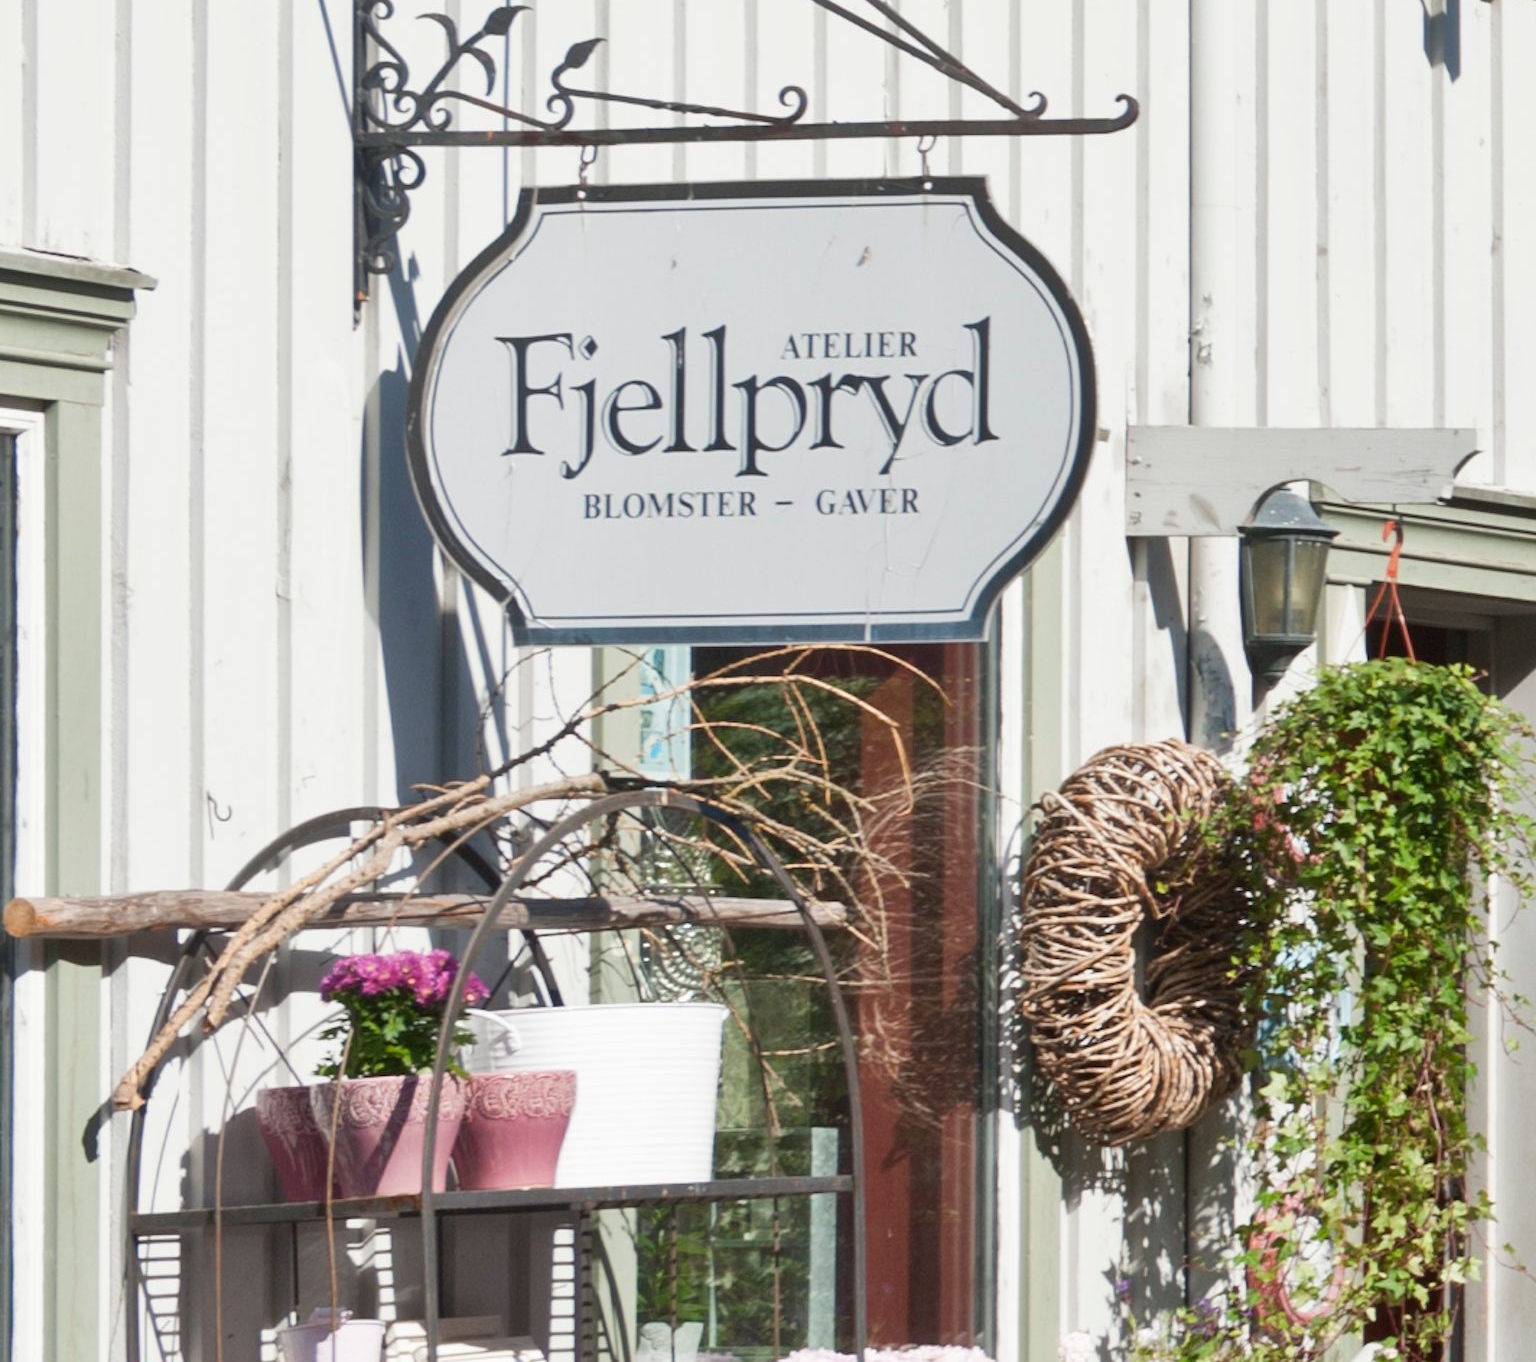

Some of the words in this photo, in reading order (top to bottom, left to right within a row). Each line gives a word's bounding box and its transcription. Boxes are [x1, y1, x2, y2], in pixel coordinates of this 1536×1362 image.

[781, 331, 918, 360] ATELIER
[494, 316, 1000, 480] Fjellpryd
[582, 491, 757, 520] BLOMSTER
[815, 488, 920, 517] GAVER
